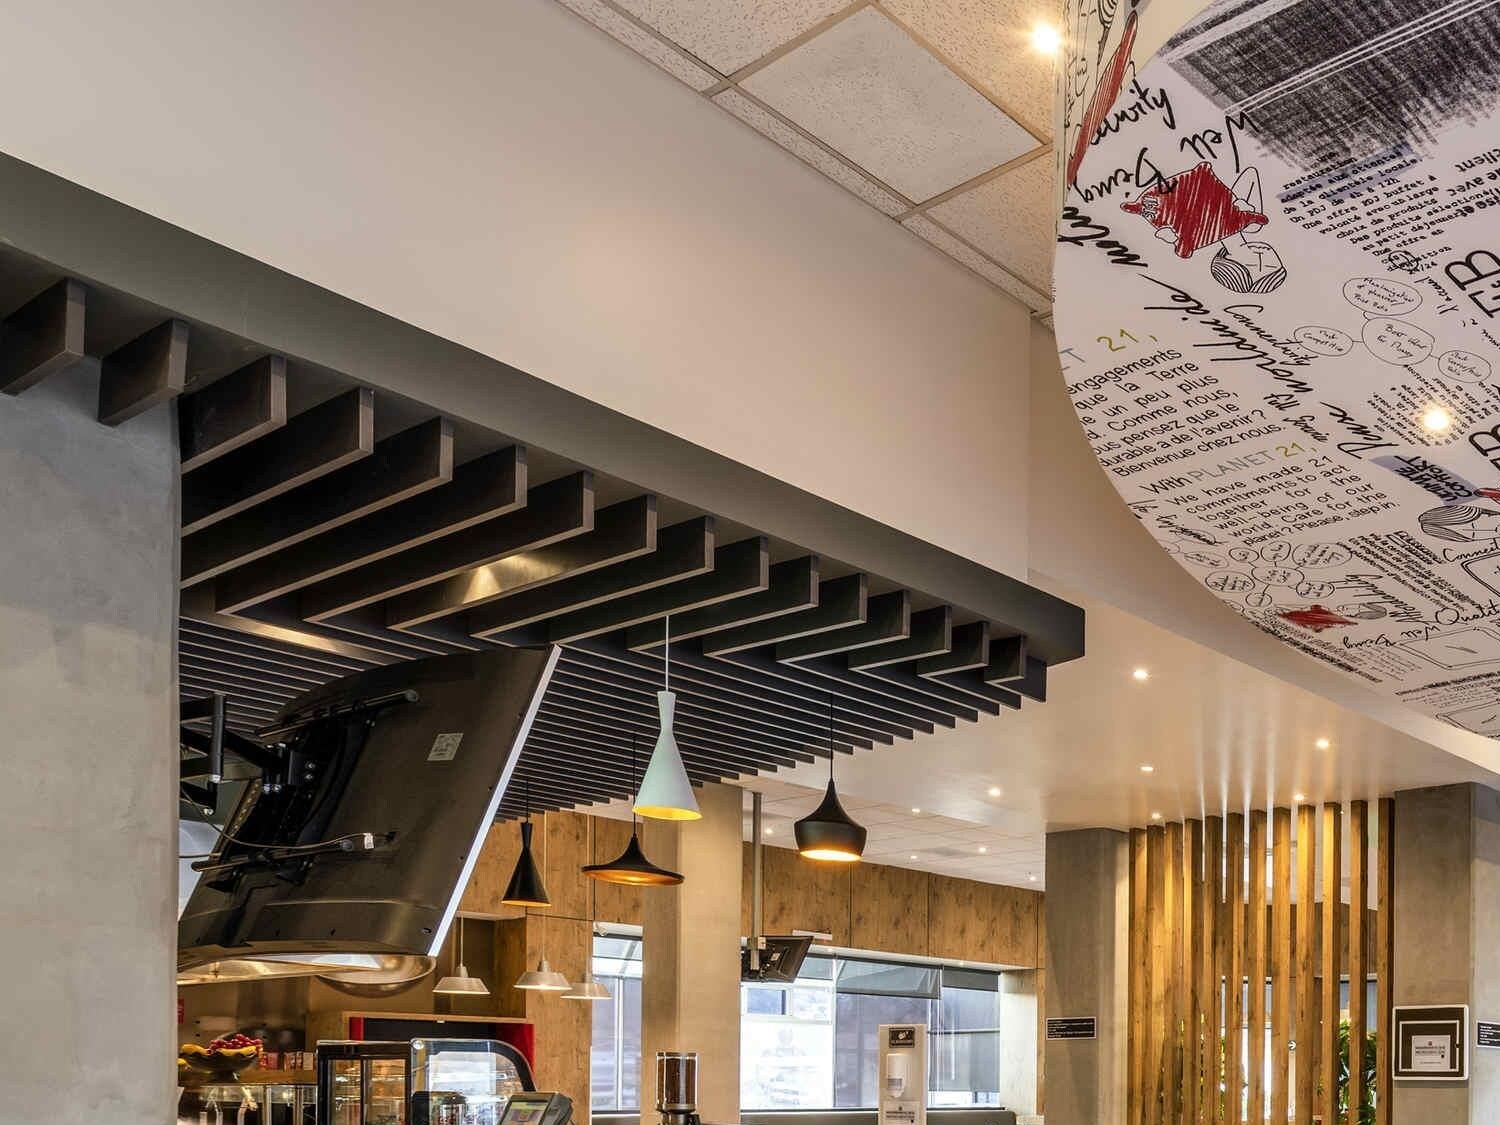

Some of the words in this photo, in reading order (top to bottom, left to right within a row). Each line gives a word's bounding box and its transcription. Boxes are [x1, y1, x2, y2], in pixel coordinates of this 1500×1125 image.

[1180, 111, 1258, 173] Well
[1445, 176, 1485, 197] avec
[1074, 393, 1108, 415] que
[1113, 378, 1141, 393] la
[1144, 362, 1199, 382] Terre
[1102, 405, 1128, 418] un
[1133, 390, 1173, 409] peu
[1176, 376, 1219, 395] plus
[1106, 405, 1177, 433] Comme
[1182, 389, 1240, 408] nous,
[1111, 446, 1198, 479] Bienvenue
[1197, 434, 1239, 454] chez
[1236, 419, 1286, 440] nous.
[1121, 420, 1186, 451] pensez
[1185, 408, 1220, 431] que
[1217, 396, 1240, 416] le
[1139, 472, 1193, 494] With
[1170, 495, 1200, 506] We
[1203, 481, 1247, 499] have
[1252, 464, 1304, 483] made
[1308, 456, 1333, 469] 21
[1183, 472, 1299, 520] commitments
[1296, 471, 1318, 483] to
[1320, 464, 1352, 479] act
[1197, 499, 1268, 522] together
[1285, 481, 1311, 498] for
[1330, 469, 1362, 487] the
[1316, 492, 1336, 503] of
[1345, 482, 1378, 499] our
